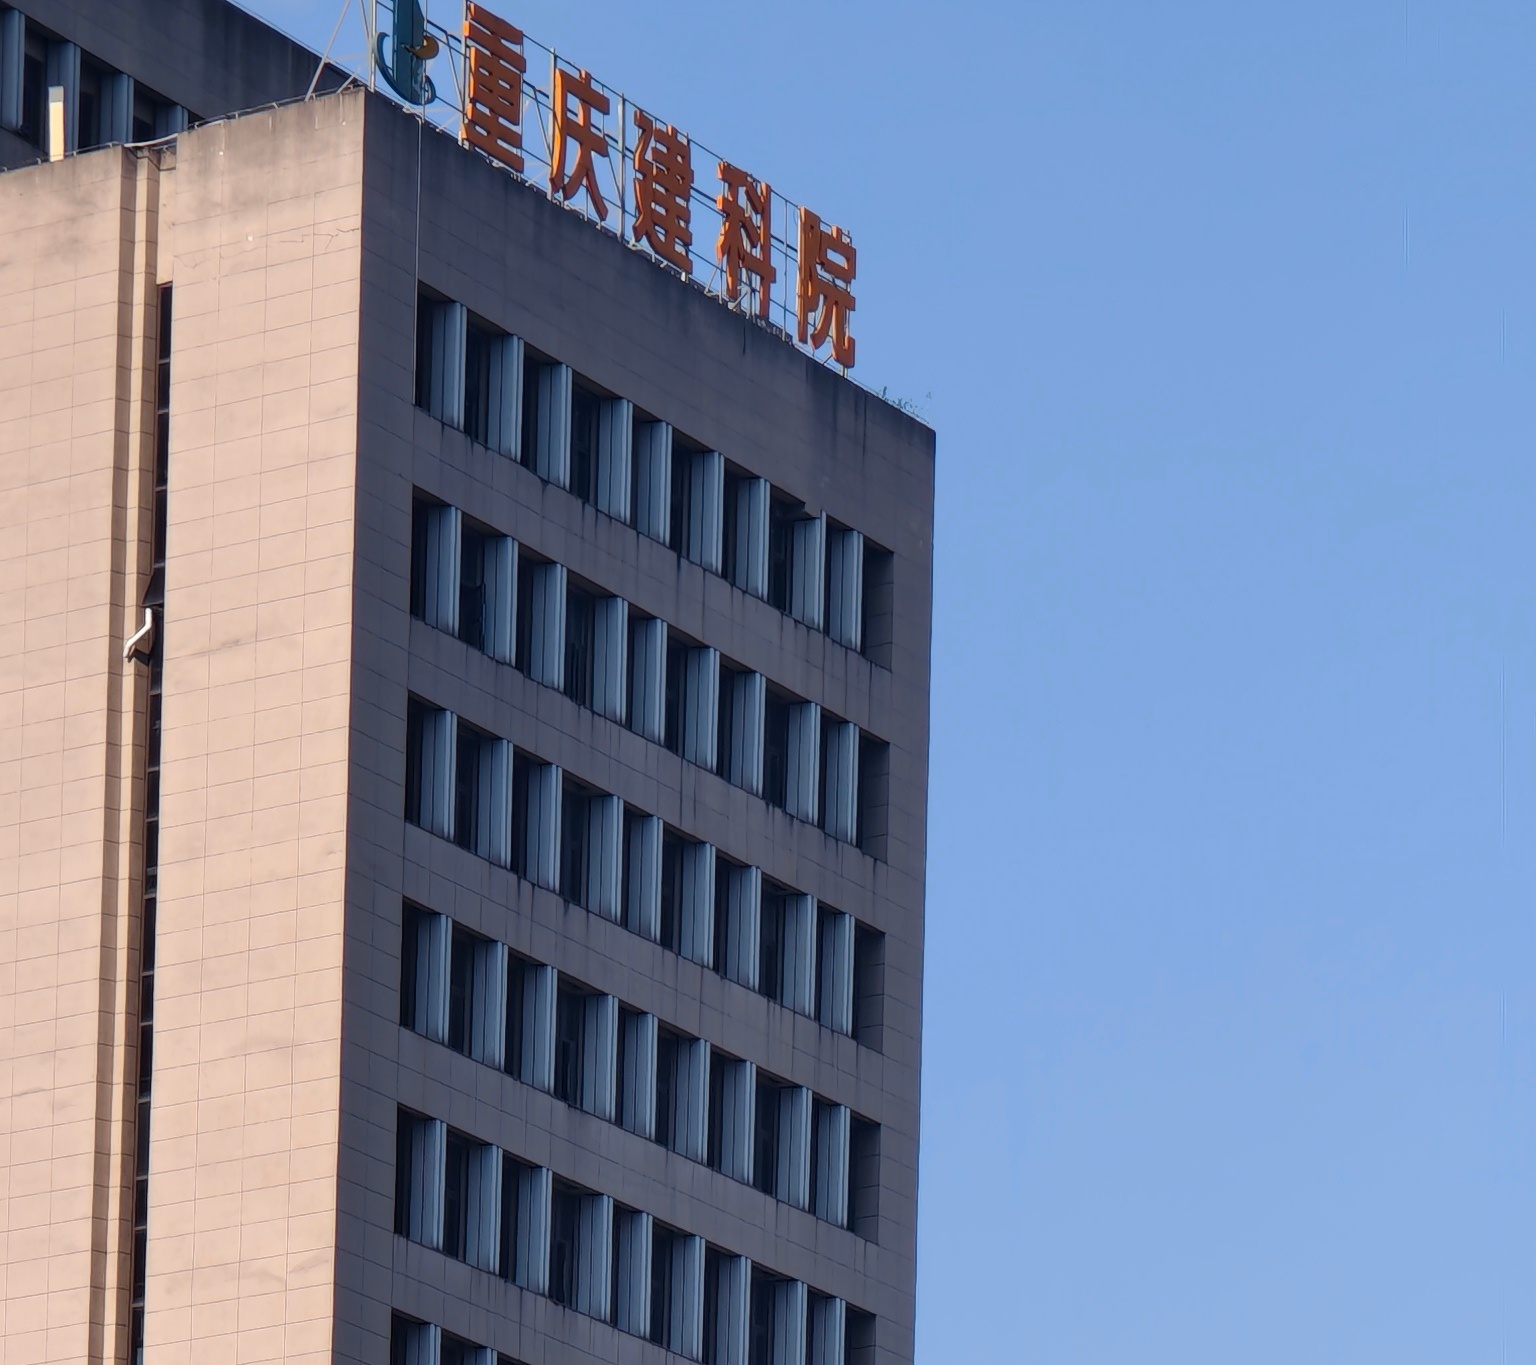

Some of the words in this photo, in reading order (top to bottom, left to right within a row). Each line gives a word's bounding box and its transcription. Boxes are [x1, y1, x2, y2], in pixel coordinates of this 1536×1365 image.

[462, 3, 857, 368] 重庆建科院
